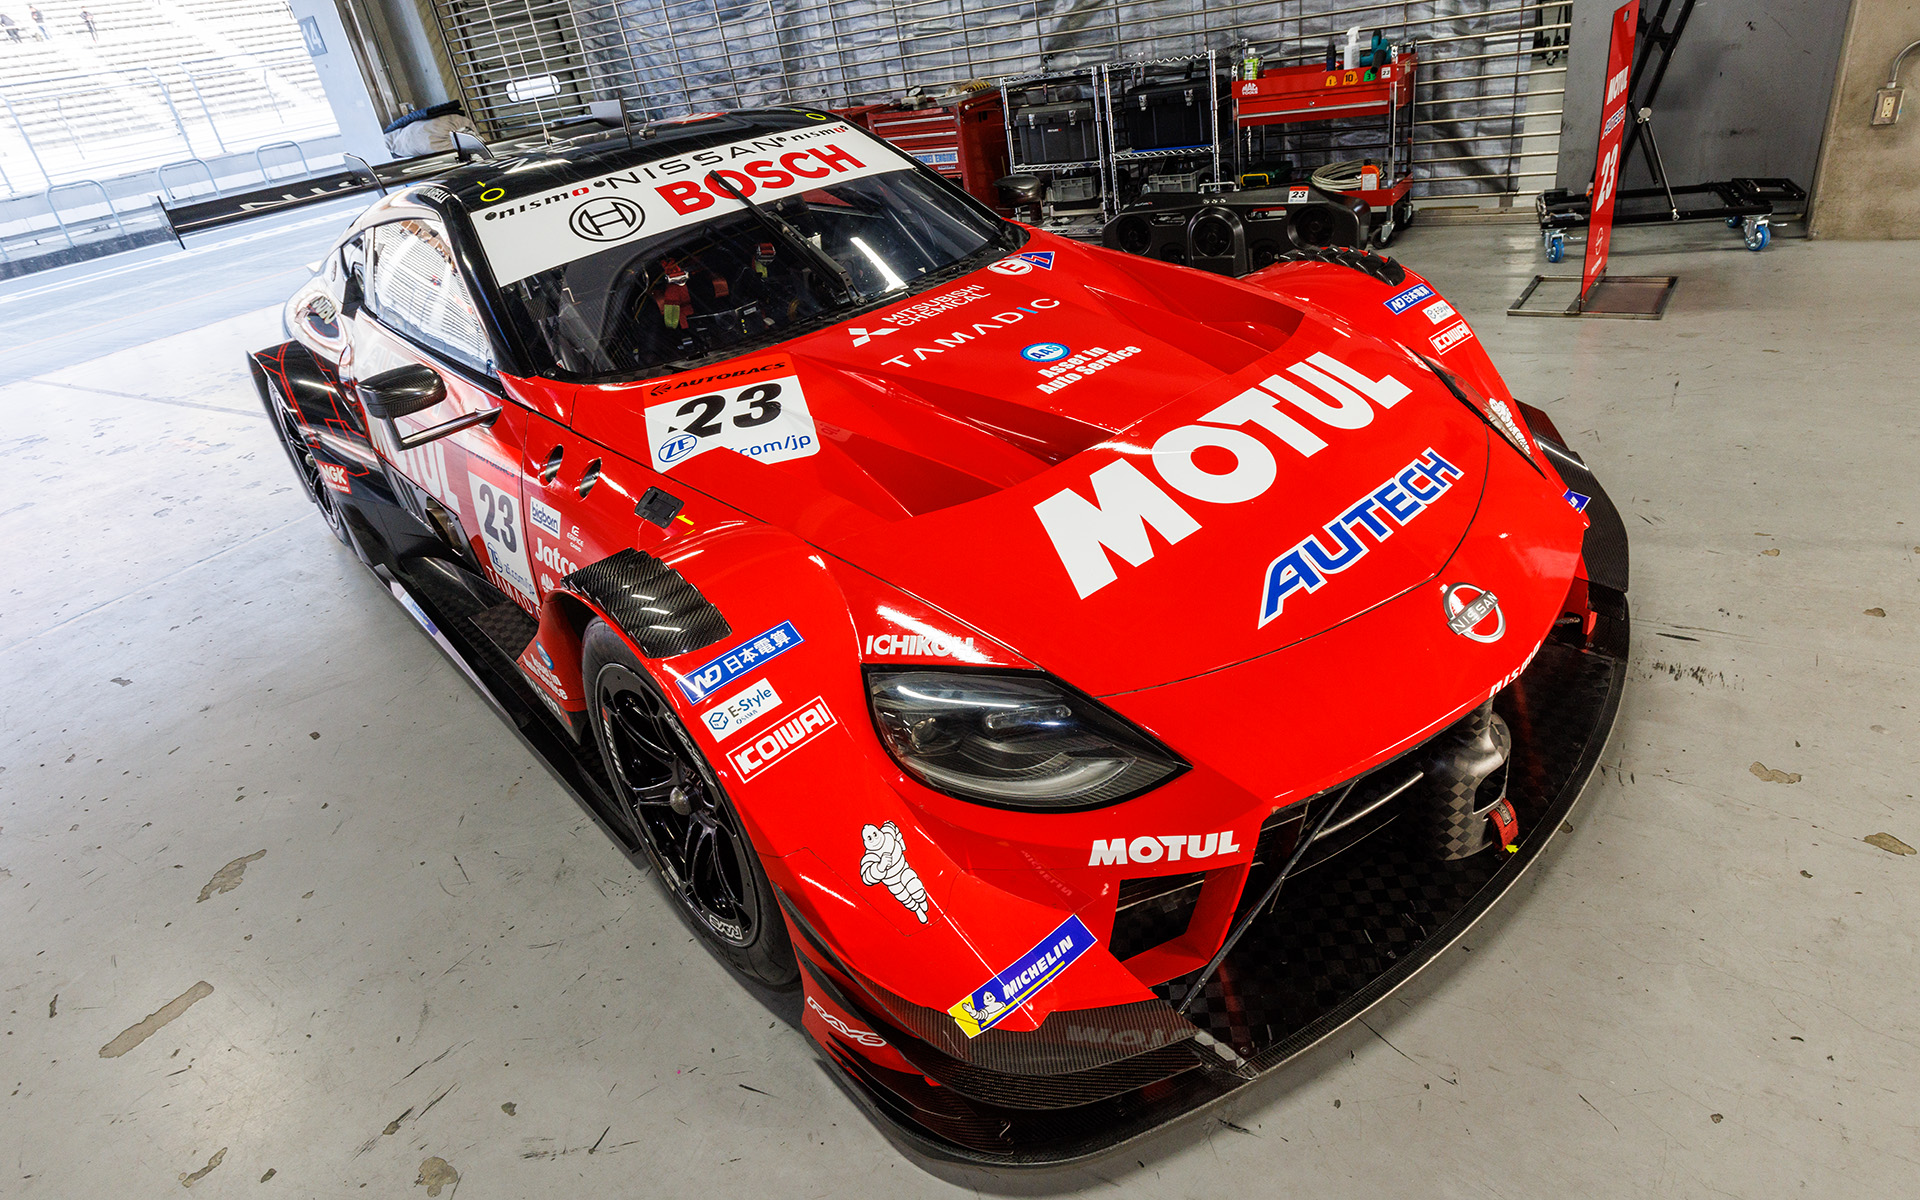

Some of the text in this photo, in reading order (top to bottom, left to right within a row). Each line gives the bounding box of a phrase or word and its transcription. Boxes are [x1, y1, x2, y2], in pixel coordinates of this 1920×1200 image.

[302, 22, 322, 50] 14
[1345, 74, 1353, 82] 10
[499, 186, 590, 220] nismo
[606, 137, 779, 190] NISSAN
[791, 126, 846, 143] nismo
[654, 144, 867, 216] BOSCH
[1595, 144, 1618, 212] 23
[1291, 191, 1306, 199] 23
[993, 261, 1027, 274] E
[881, 284, 985, 323] MITSUBISHI
[896, 291, 992, 327] CHEMICAL
[881, 298, 1060, 367] TAMADIC
[1031, 345, 1061, 359] AAS
[673, 362, 786, 390] AUTOBACS
[1036, 345, 1142, 395] Auto Service
[1038, 346, 1109, 379] Asset in
[668, 383, 782, 438] 23
[320, 464, 347, 485] NGK
[1033, 352, 1413, 600] MOTUL
[479, 484, 517, 553] 23
[1258, 447, 1464, 629] AUTECH
[1451, 592, 1498, 632] NISSAN
[723, 629, 791, 674] 日本電算
[1488, 640, 1541, 698] nismo
[728, 689, 772, 718] E-Style
[1088, 830, 1240, 867] MOTUL
[1002, 935, 1074, 1001] MICHELIN
